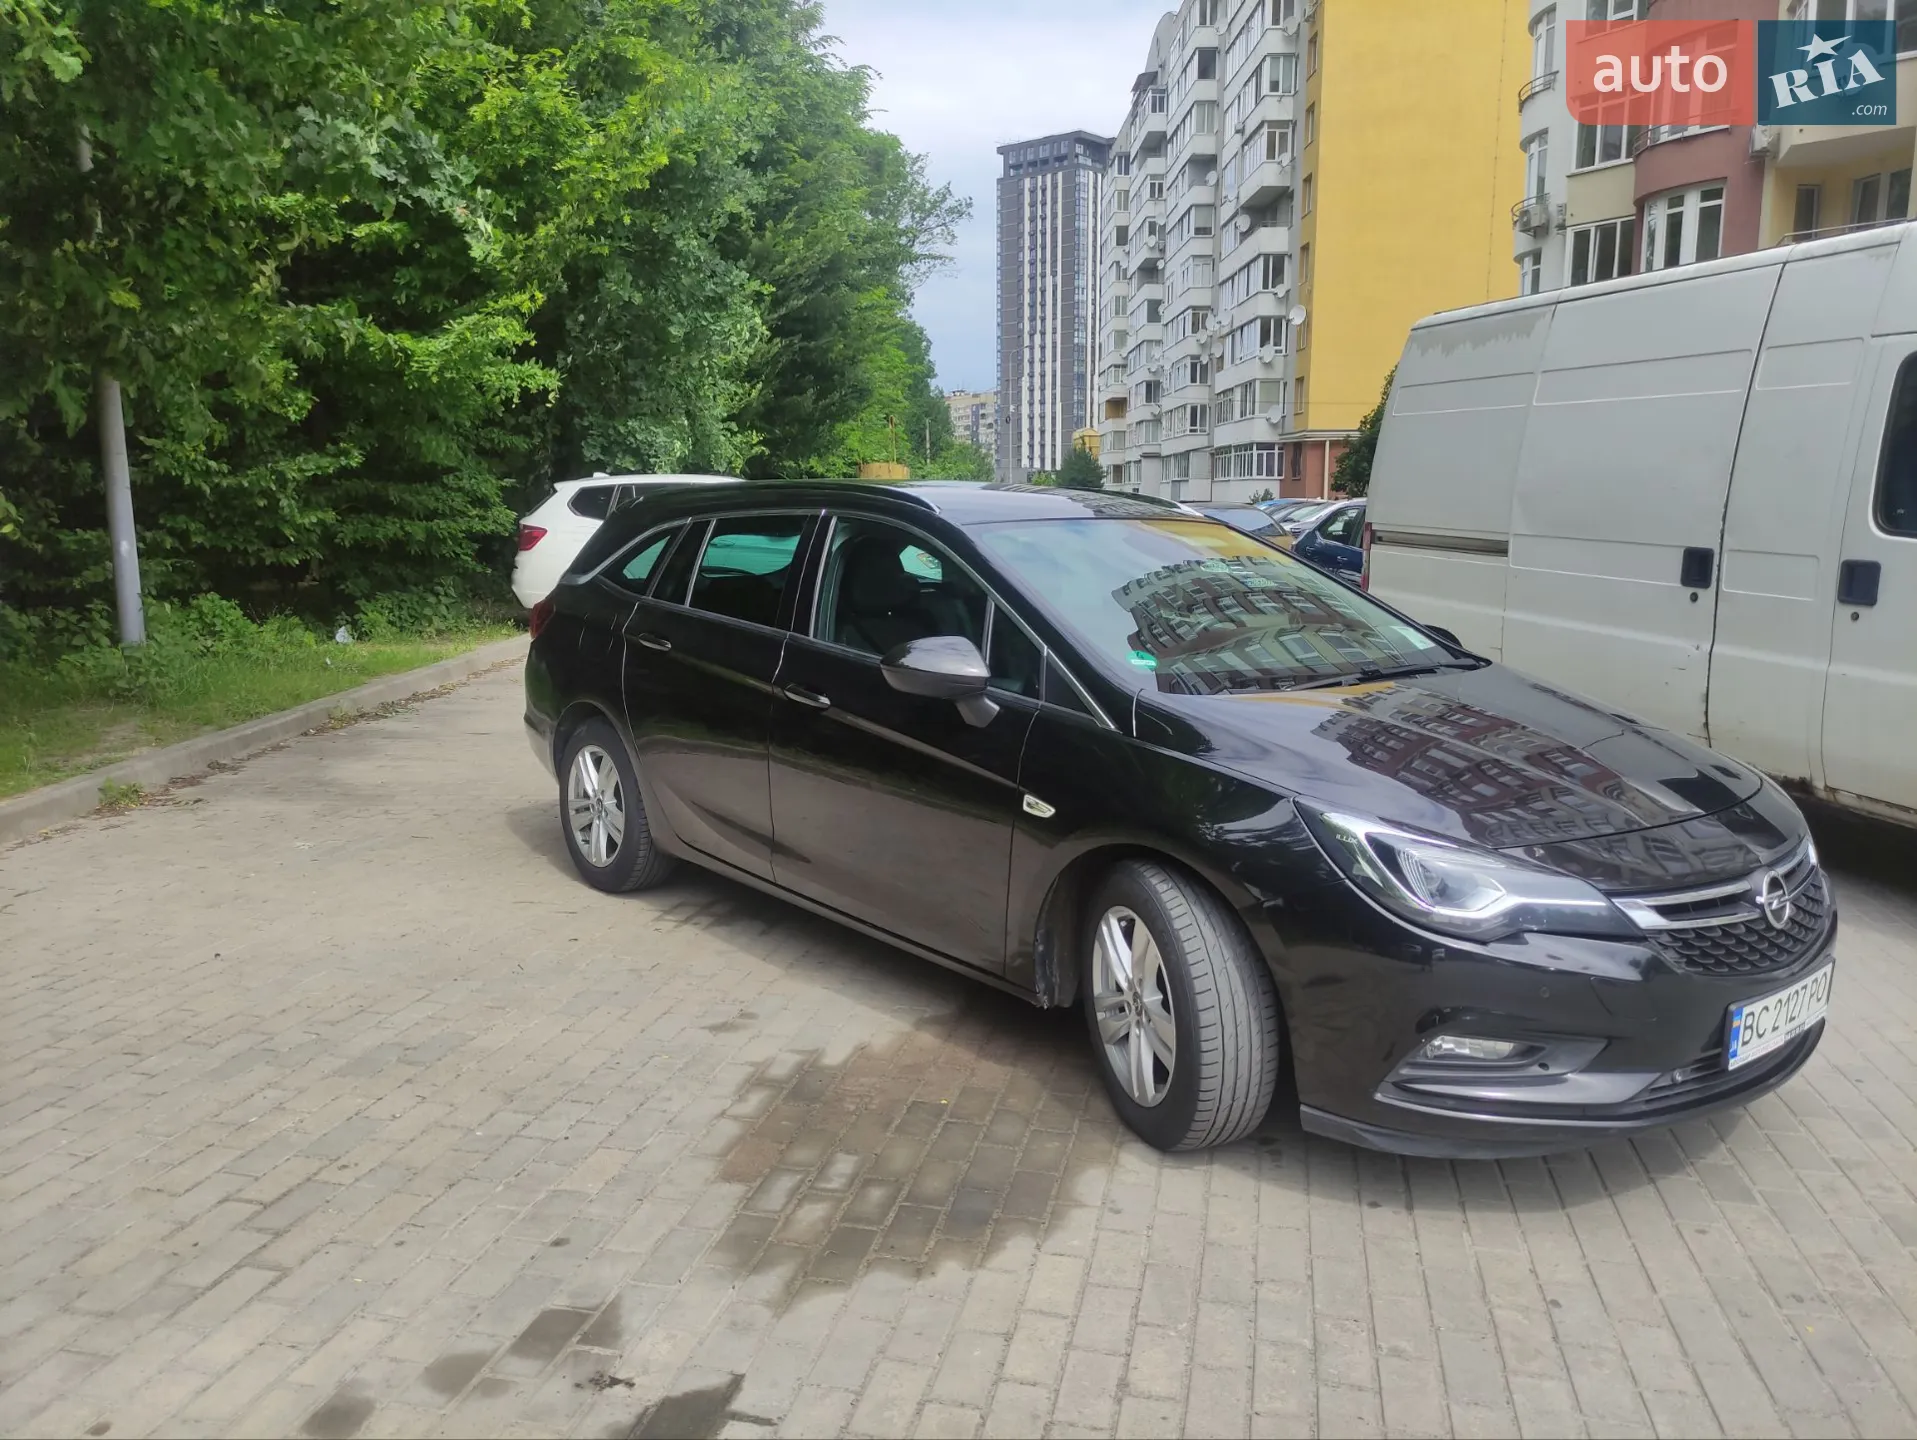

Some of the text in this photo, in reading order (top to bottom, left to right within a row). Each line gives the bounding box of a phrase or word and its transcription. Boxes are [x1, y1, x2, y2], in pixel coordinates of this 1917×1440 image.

[1741, 1005, 1770, 1047] BC
[1771, 983, 1808, 1033] 2127
[1807, 971, 1828, 1011] PO
